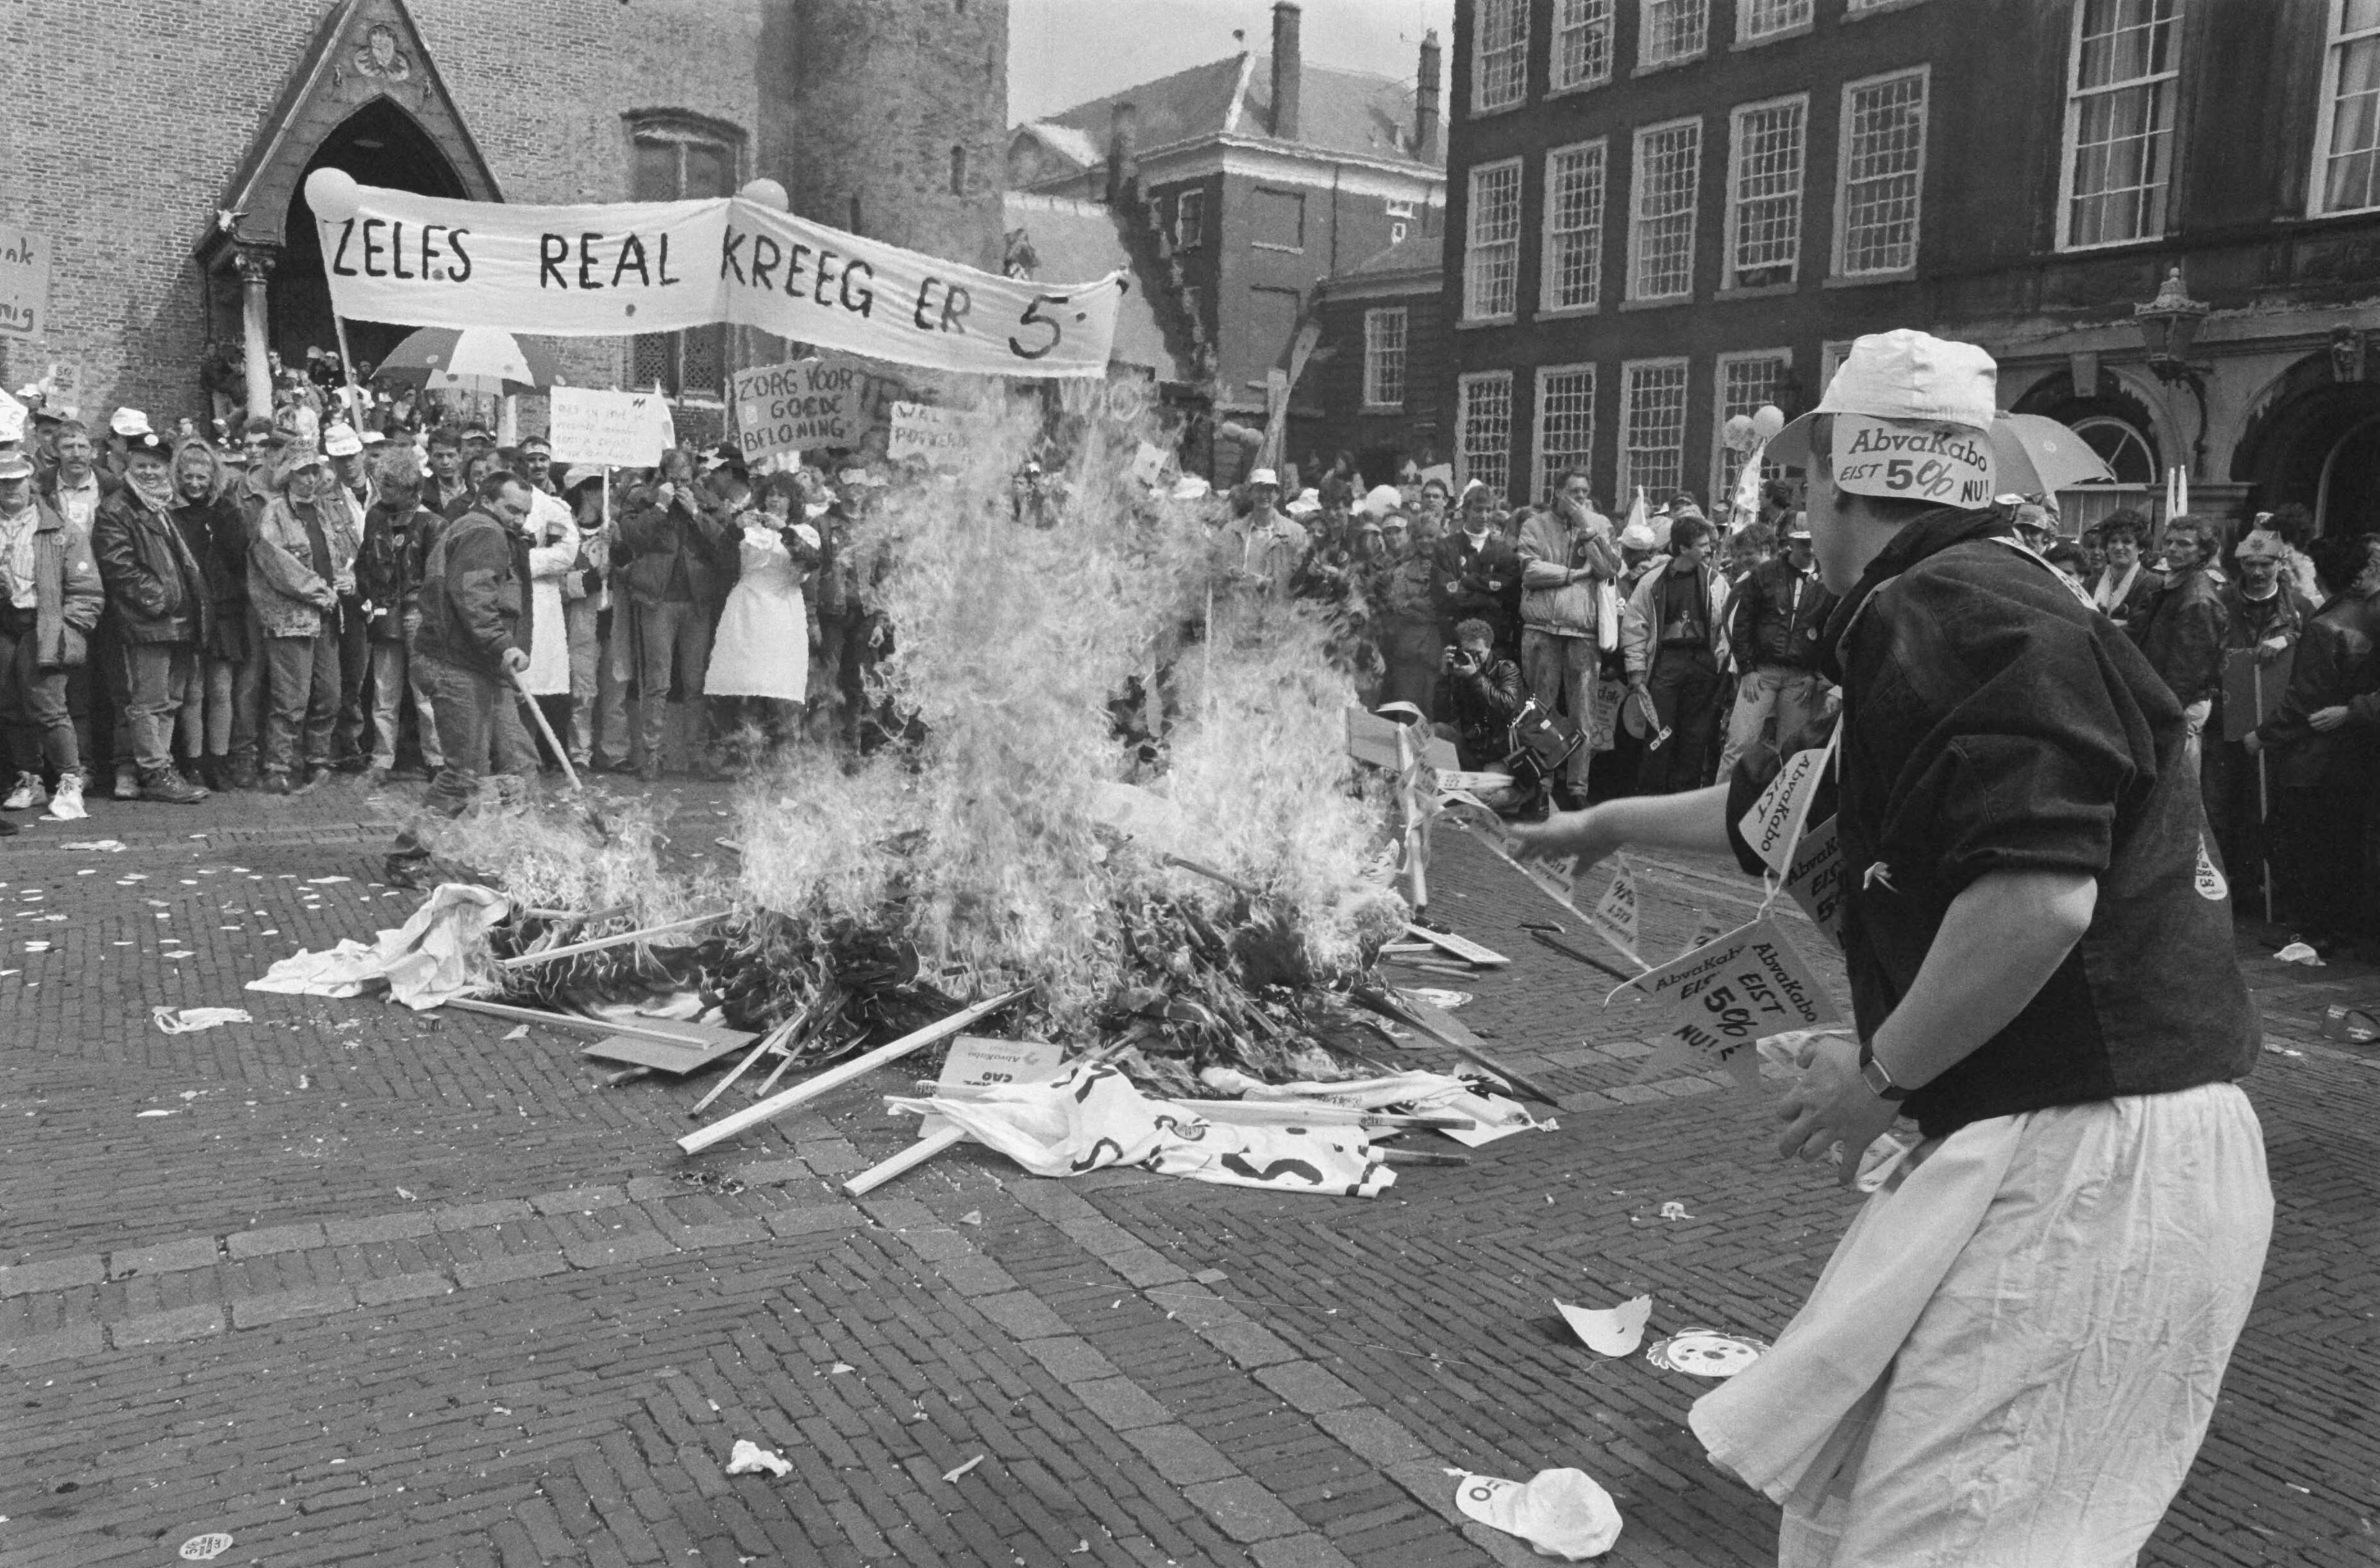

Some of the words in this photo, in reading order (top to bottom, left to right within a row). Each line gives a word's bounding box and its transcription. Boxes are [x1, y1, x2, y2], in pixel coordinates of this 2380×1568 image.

[333, 217, 471, 282] ZELFS
[540, 232, 680, 289] REAL
[721, 224, 873, 318] KREEG
[914, 277, 971, 333] ER
[739, 368, 798, 401] ZORG
[805, 362, 853, 392] VOOR
[771, 394, 843, 419] GOEDE
[1848, 428, 1986, 472] AbvaKabo
[1839, 464, 1883, 481] EIST
[1886, 459, 1954, 498] 5%
[1960, 479, 1990, 503] NU!
[1761, 753, 1811, 852] AbvaKabo
[1787, 836, 1838, 886] AbvaK
[1738, 973, 1786, 1015] EIST
[1751, 941, 1818, 1022] AbvaKabo
[1704, 985, 1758, 1037] 5%
[1672, 1024, 1720, 1053] NU!
[982, 1071, 1013, 1083] CAO
